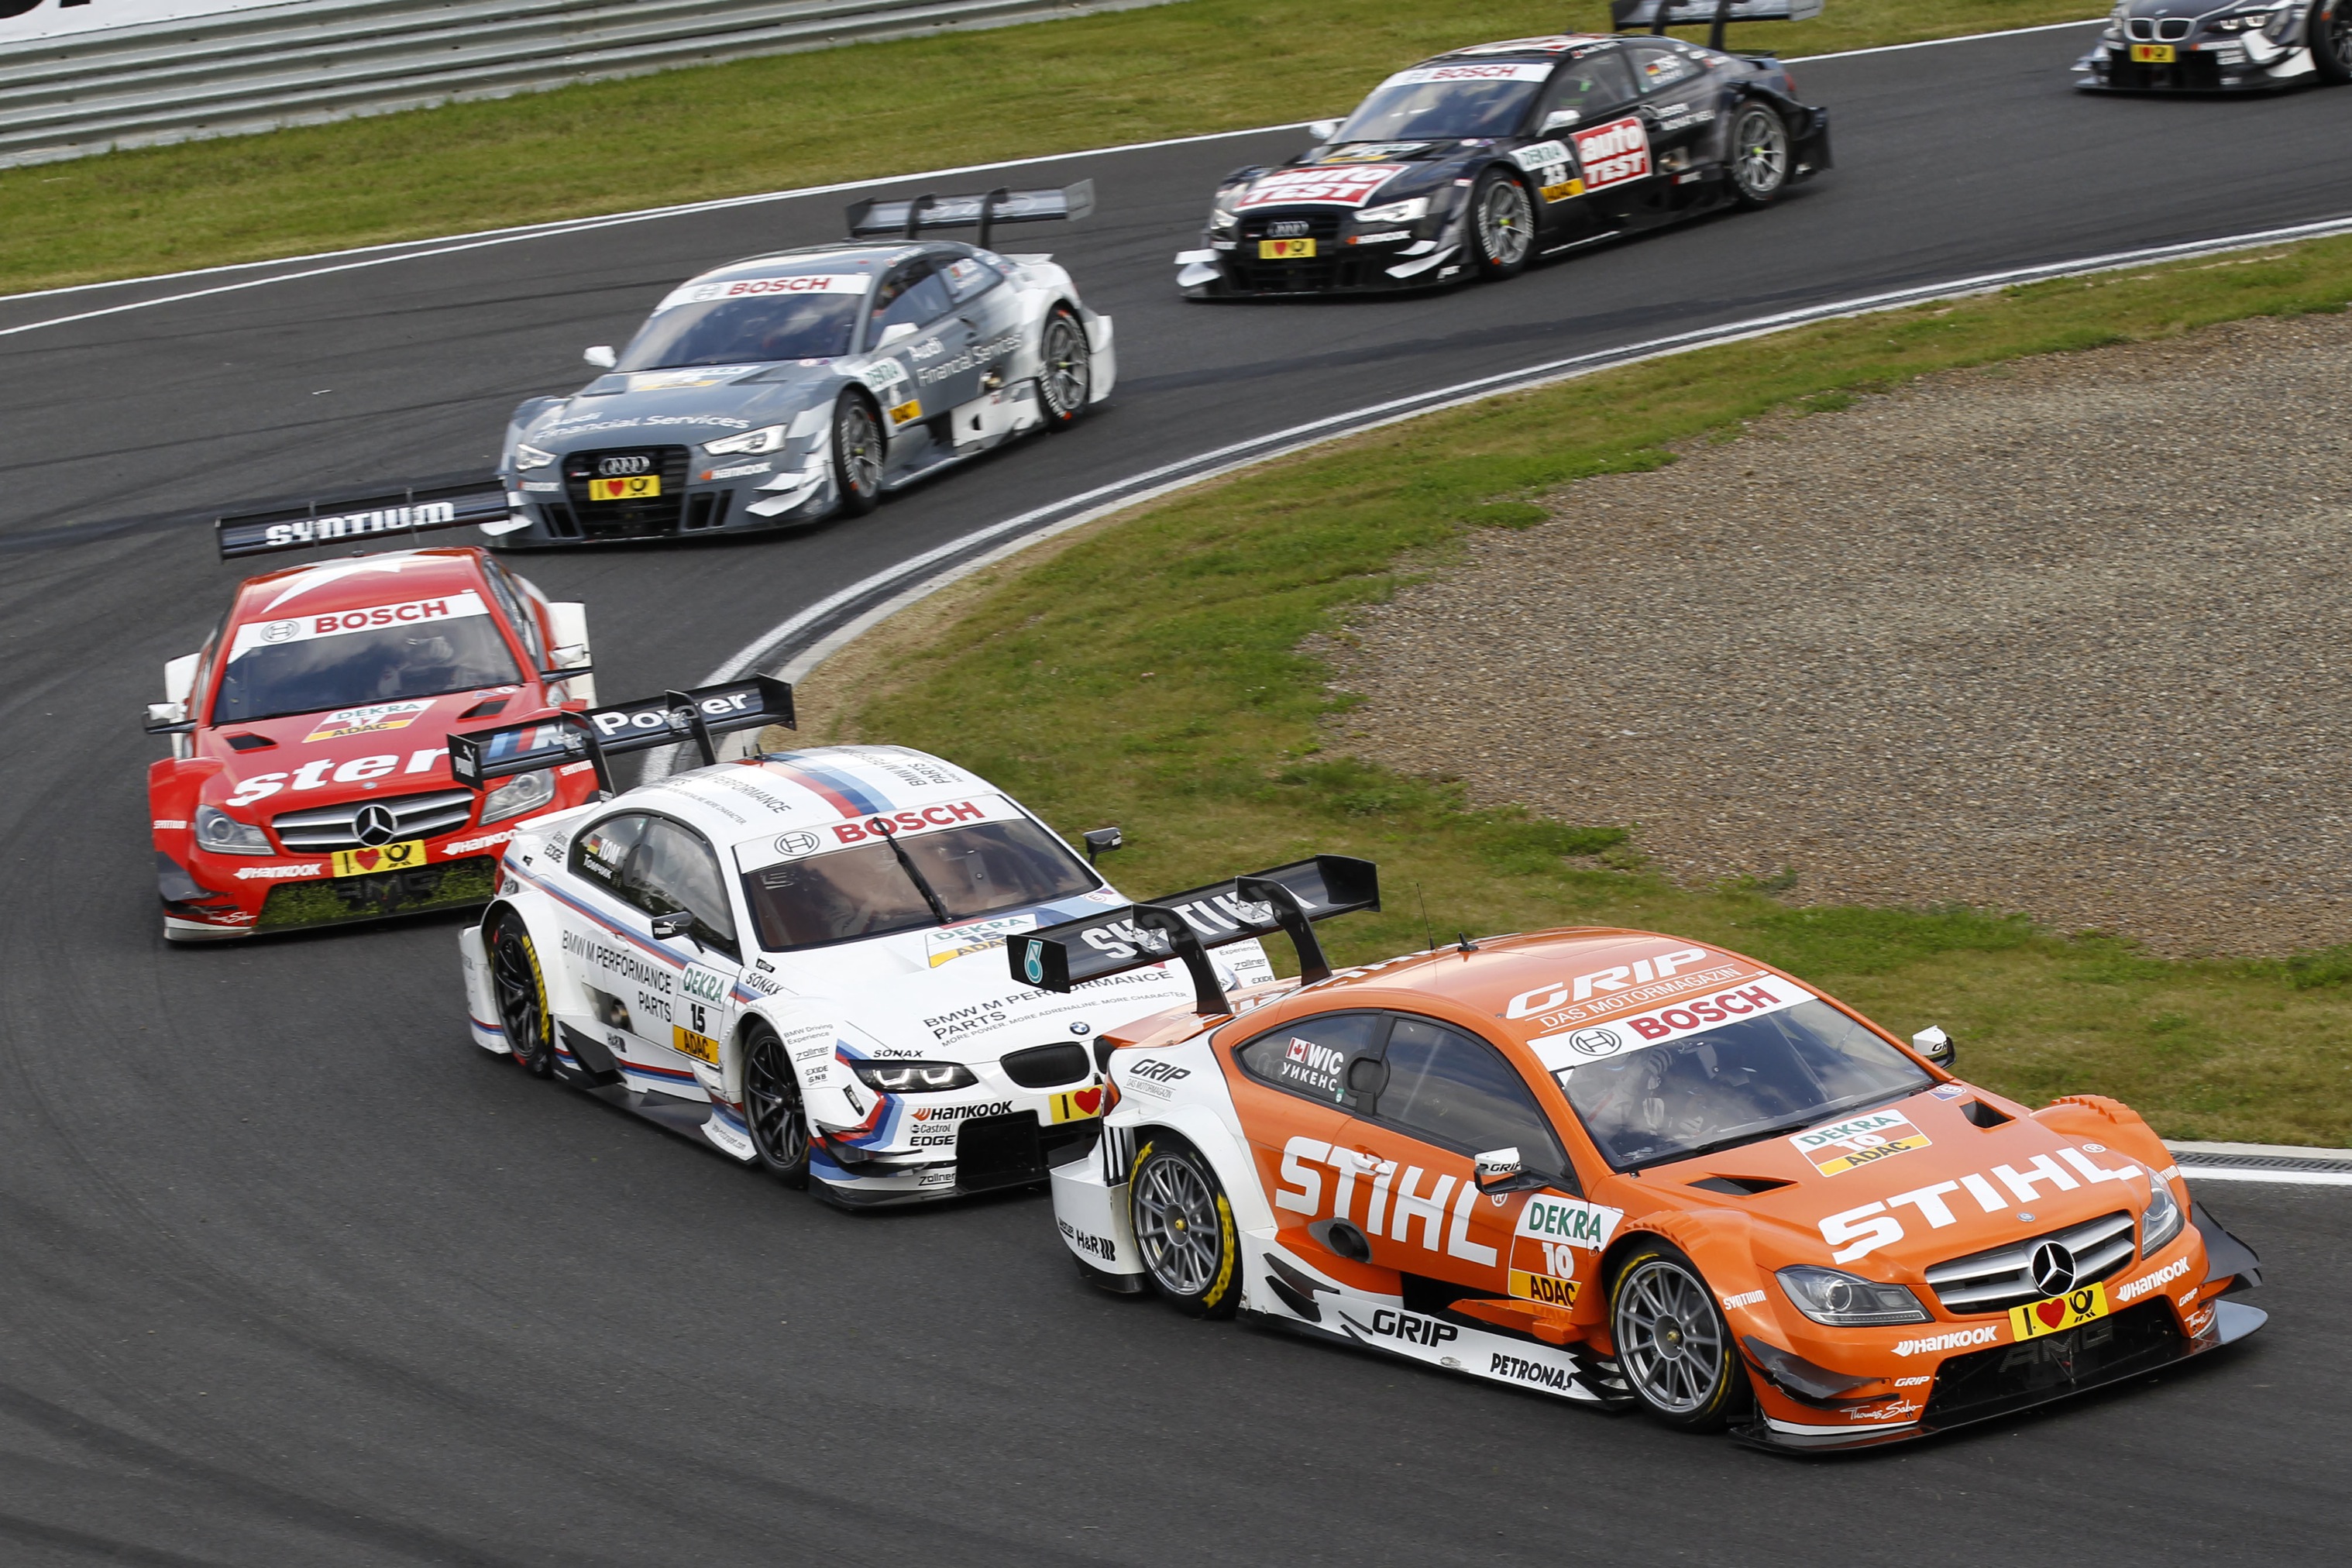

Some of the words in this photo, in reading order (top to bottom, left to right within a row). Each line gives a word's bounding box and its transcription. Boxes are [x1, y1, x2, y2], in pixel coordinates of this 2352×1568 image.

[1432, 66, 1518, 79] BOSCH
[1580, 125, 1643, 163] auto
[1583, 151, 1645, 185] TEST
[1243, 183, 1377, 203] TEST
[727, 277, 831, 296] BOSCH
[916, 349, 975, 387] Financial
[642, 414, 752, 430] Services
[315, 600, 450, 634] BOSCH
[336, 703, 421, 720] DEKRA
[346, 714, 387, 728] 17
[592, 693, 748, 736] Poer
[331, 722, 390, 738] ADAC
[225, 747, 451, 807] ster
[831, 801, 986, 844] BOSCH
[598, 837, 621, 865] TOM
[932, 917, 1030, 940] DEKRA
[960, 930, 1007, 944] 15
[562, 930, 586, 958] BMW
[586, 940, 596, 962] M
[596, 945, 672, 995] PERFORMANCE
[1219, 945, 1260, 956] Experience
[683, 968, 725, 1004] DEKRA
[745, 972, 784, 996] SONAX
[1250, 975, 1274, 984] EXIDE
[1505, 947, 1707, 1020] GRIP
[638, 990, 672, 1023] PARTS
[922, 1005, 978, 1028] BMW
[981, 999, 1005, 1012] M
[1005, 970, 1174, 1006] PERORMANCE
[1539, 1008, 1588, 1029] DAS
[1586, 966, 1744, 1015] MOTORMAGAZIN
[1626, 985, 1783, 1040] BOSCH
[690, 1002, 706, 1034] 15
[783, 1027, 805, 1039] BMW
[805, 1022, 834, 1034] Driving
[932, 1010, 1007, 1041] PARTS
[940, 1033, 971, 1048] MORE
[1009, 1013, 1039, 1026] MORE
[1100, 996, 1130, 1006] MORE
[683, 1030, 710, 1061] ADAC
[787, 1030, 830, 1045] Experience
[873, 1049, 924, 1058] SONAX
[1307, 1043, 1344, 1075] WIC
[804, 1064, 829, 1076] EXIDE
[1130, 1058, 1191, 1083] GRIP
[1281, 1061, 1338, 1092] УИКЕНС
[1126, 1078, 1136, 1088] DAS
[1136, 1080, 1173, 1099] MOTORMAGAZIN
[910, 1134, 957, 1147] EDGE
[920, 1123, 952, 1133] Castrol
[1798, 1116, 1901, 1146] DEKRA
[1832, 1133, 1888, 1152] 10
[1844, 1141, 1912, 1167] ADAC
[1275, 1136, 1498, 1268] STIHL
[1817, 1147, 2146, 1266] STIHL
[1528, 1201, 1602, 1243] DEKRA
[1541, 1241, 1575, 1280] 10
[1529, 1274, 1576, 1306] ADAC
[2178, 1287, 2199, 1308] GRIP
[1372, 1308, 1459, 1348] GRIP
[1490, 1352, 1575, 1391] PETRONAS
[1893, 1375, 1931, 1387] GRIP
[1839, 1405, 1883, 1421] Thomas
[1880, 1398, 1924, 1420] Sabo
